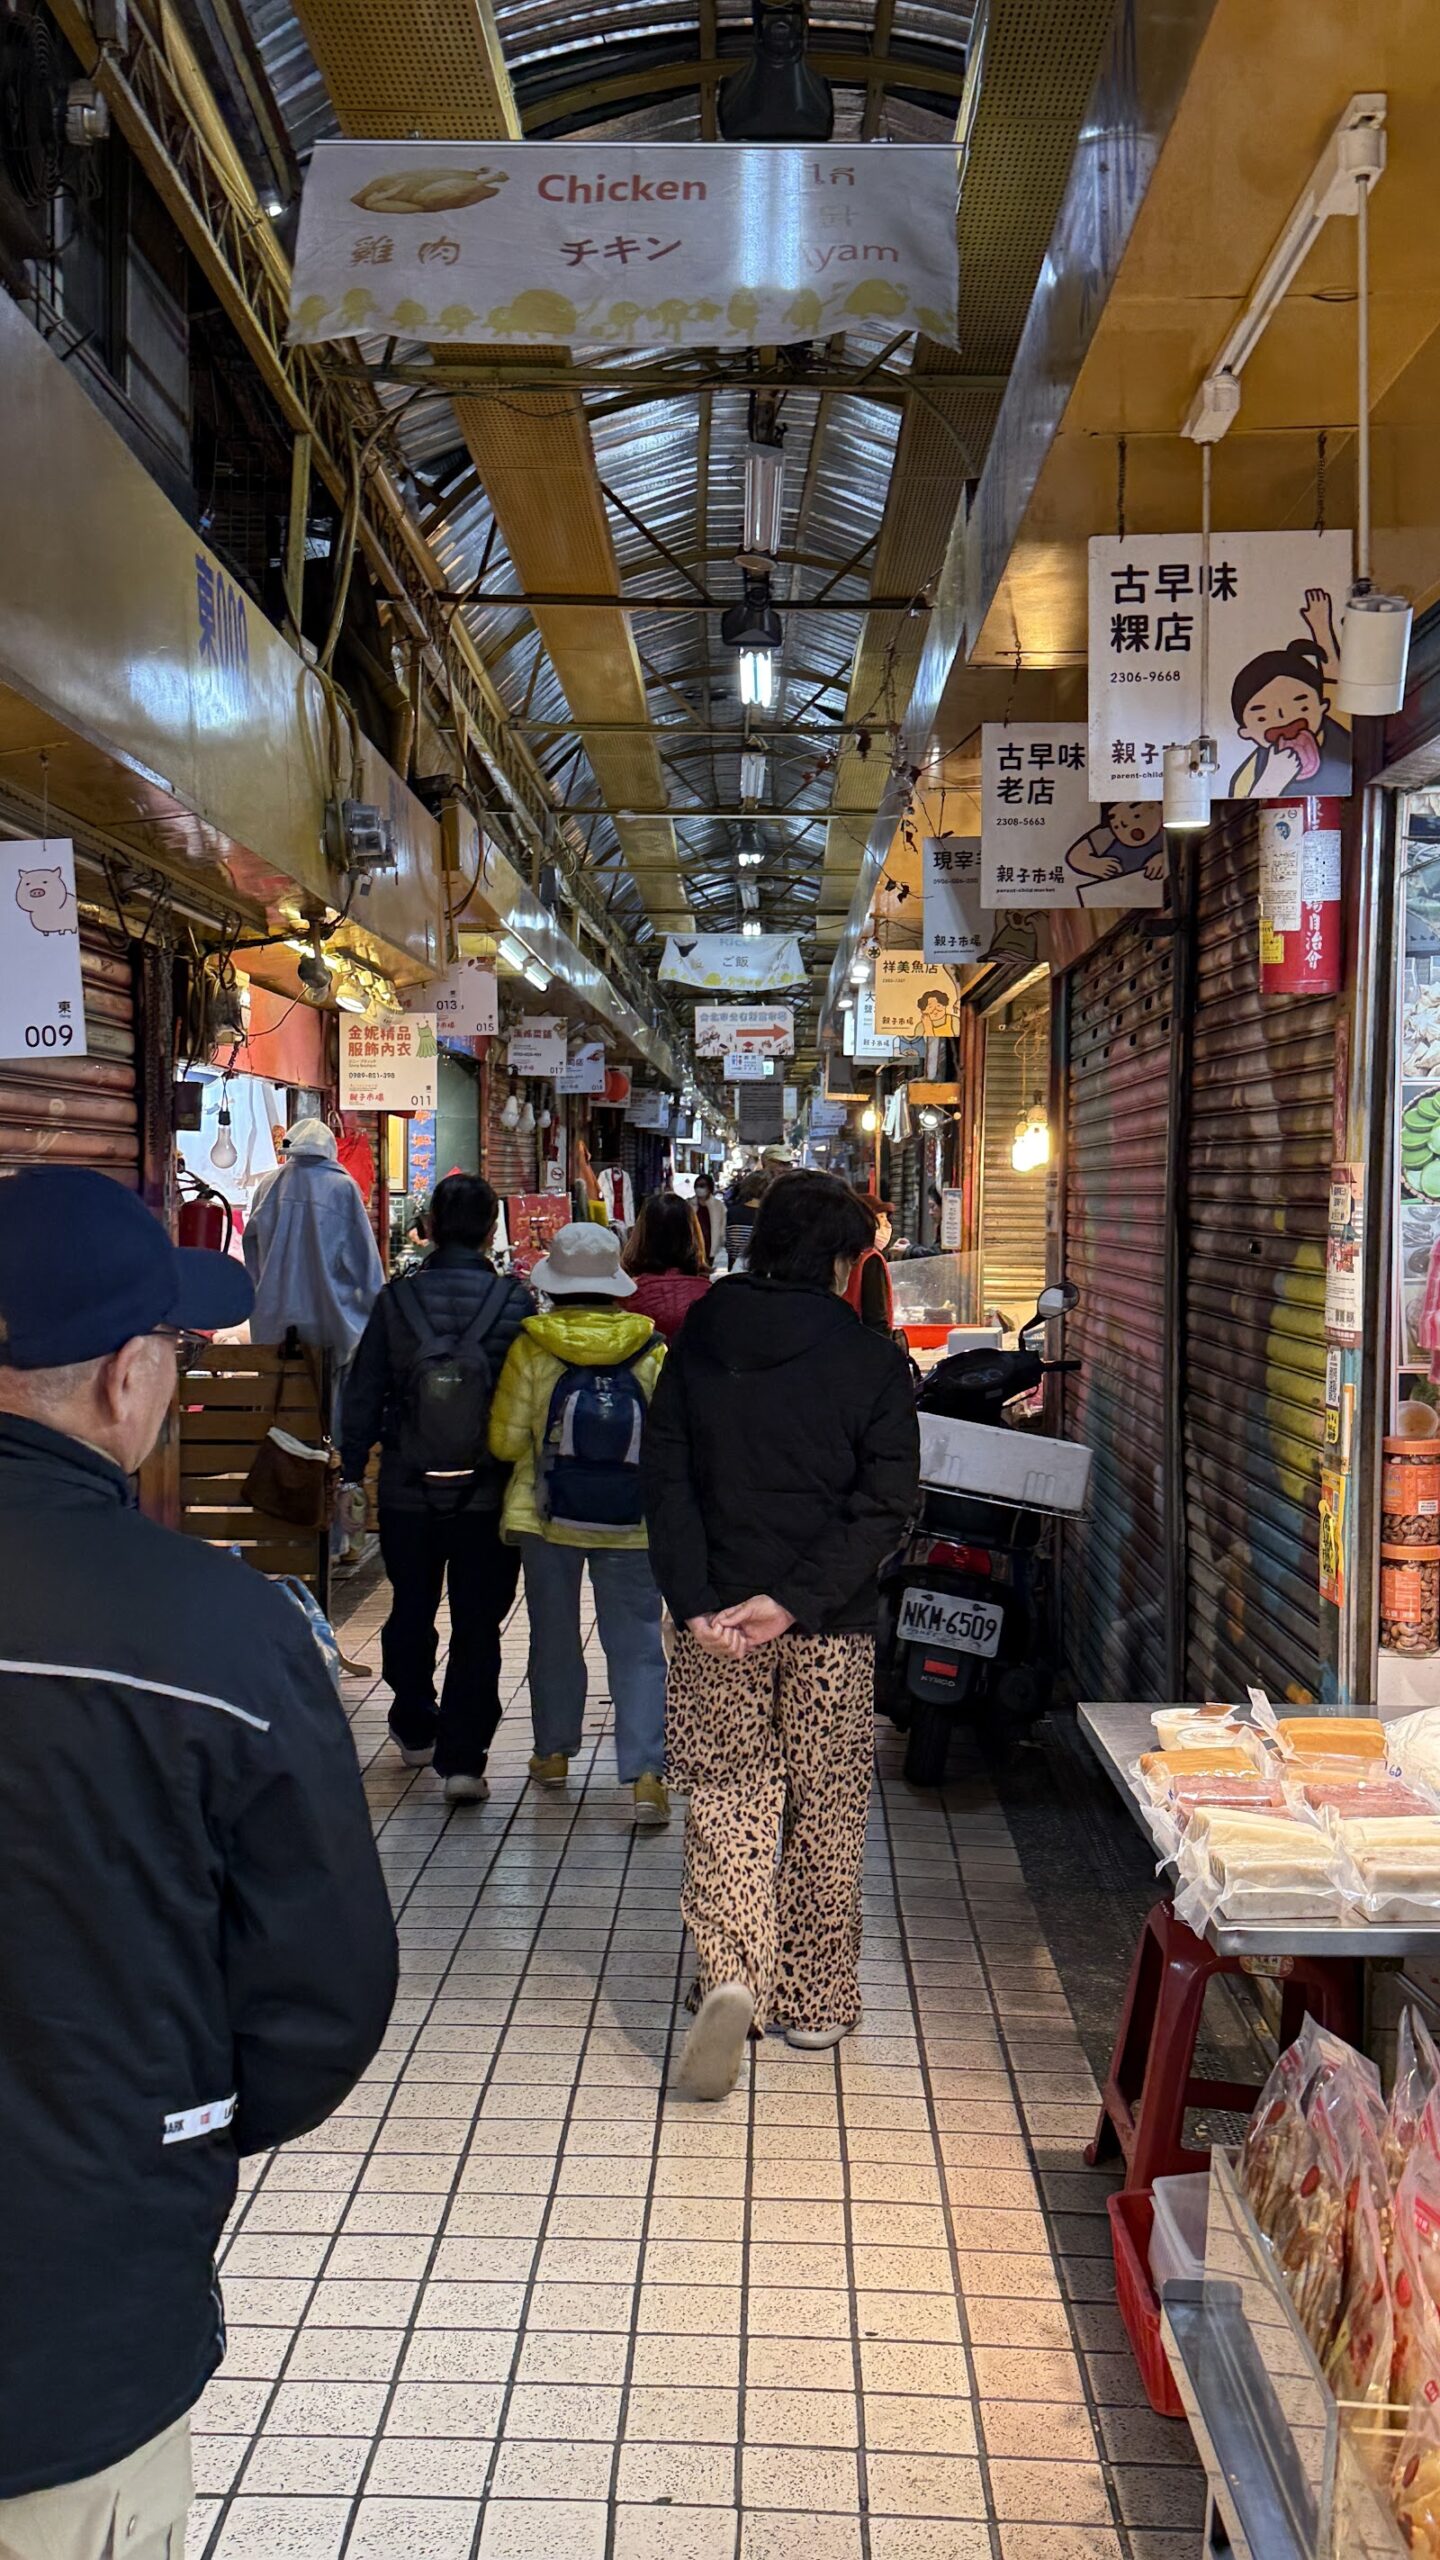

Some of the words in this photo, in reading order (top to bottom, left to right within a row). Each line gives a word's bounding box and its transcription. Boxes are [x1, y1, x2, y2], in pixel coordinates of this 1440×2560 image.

[537, 173, 708, 204] Chicken
[560, 236, 682, 266] チキン
[1110, 562, 1238, 604] 古早味
[1110, 612, 1194, 653] 粿店
[1110, 670, 1181, 683] 2306-9668
[997, 742, 1086, 771] 古早味
[1111, 739, 1183, 765] 親子
[996, 776, 1056, 805] 老店
[996, 817, 1046, 827] 2308-5663
[996, 865, 1065, 884] 親子市場
[436, 1000, 458, 1011] 013
[25, 1024, 73, 1048] 009
[348, 1025, 412, 1041] 金妮精品
[476, 1023, 495, 1032] 015
[410, 1095, 431, 1106] 011
[902, 1600, 998, 1642] NKM-6509
